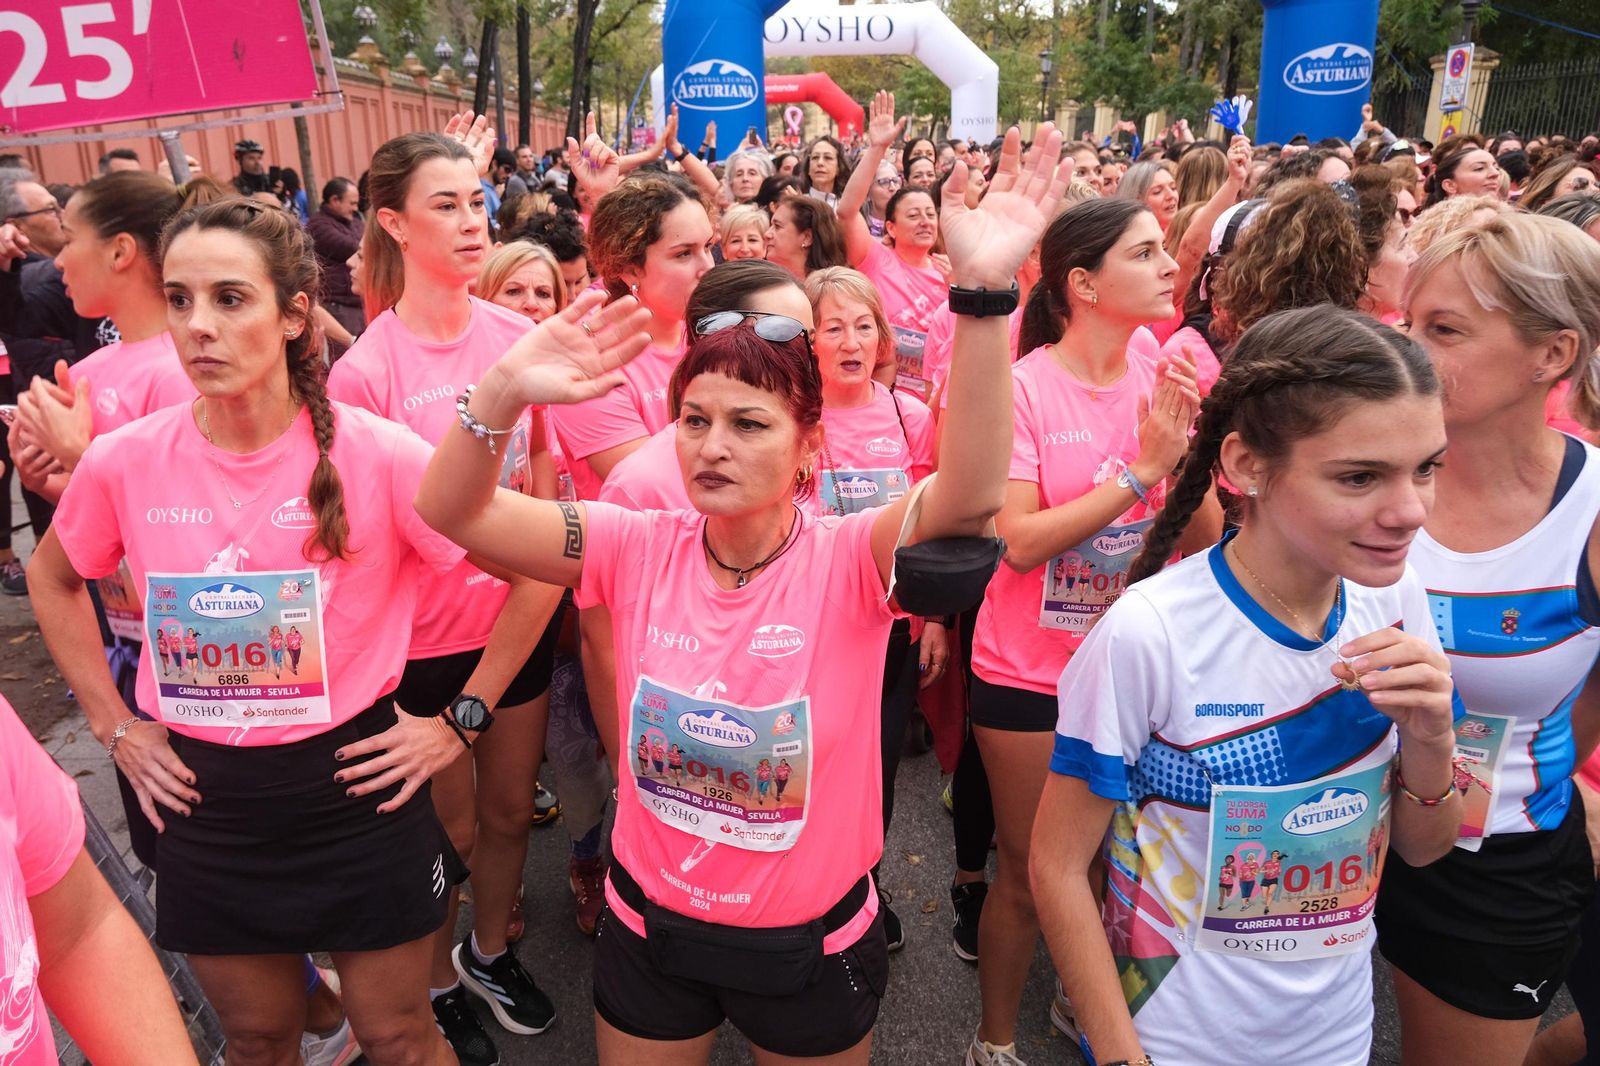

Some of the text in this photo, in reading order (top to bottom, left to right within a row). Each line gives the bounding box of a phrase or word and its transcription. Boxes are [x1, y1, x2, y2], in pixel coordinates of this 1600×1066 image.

[764, 14, 893, 44] OYSHO
[678, 80, 754, 99] ASTURIANA
[765, 84, 799, 92] antander
[403, 384, 454, 410] OYSHO
[839, 486, 877, 494] STURIANA
[147, 507, 213, 524] OYSHO
[276, 511, 316, 523] ASTURIA
[1096, 537, 1140, 551] ASTURIANA
[1092, 571, 1121, 592] 01
[194, 598, 260, 611] ASTURIANA
[1105, 594, 1120, 604] 500
[1062, 603, 1091, 612] CARRERA
[1092, 604, 1101, 612] DE
[1055, 615, 1089, 625] OYSH
[751, 637, 802, 650] ASTURIANA
[201, 642, 267, 668] 016
[218, 674, 249, 685] 6896
[178, 686, 209, 697] CARRERA
[211, 687, 220, 696] DE
[222, 687, 234, 696] LA
[235, 686, 262, 696] MUJER
[268, 686, 300, 696] SEVILLA
[176, 704, 309, 717] OYSHO Santander
[1195, 703, 1265, 717] BORDISPORT
[682, 718, 752, 743] ASTURIANA
[686, 759, 750, 793] 016
[703, 786, 733, 802] 1926
[656, 785, 781, 820] CARRERA DE LA MUJER SEVILLA
[1226, 808, 1266, 819] SUMA
[1288, 801, 1364, 830] ASTURIANA
[734, 827, 786, 841] Santander
[1283, 855, 1363, 893] 016
[660, 868, 751, 904] CARRERA DE LA MUJER
[689, 897, 711, 911] 2024
[1300, 897, 1338, 913] 2528
[1235, 916, 1282, 930] CARRERA
[1285, 917, 1299, 927] DE
[1302, 916, 1316, 926] LA
[1318, 911, 1350, 925] MUJER
[1224, 938, 1297, 952] OYSHO
